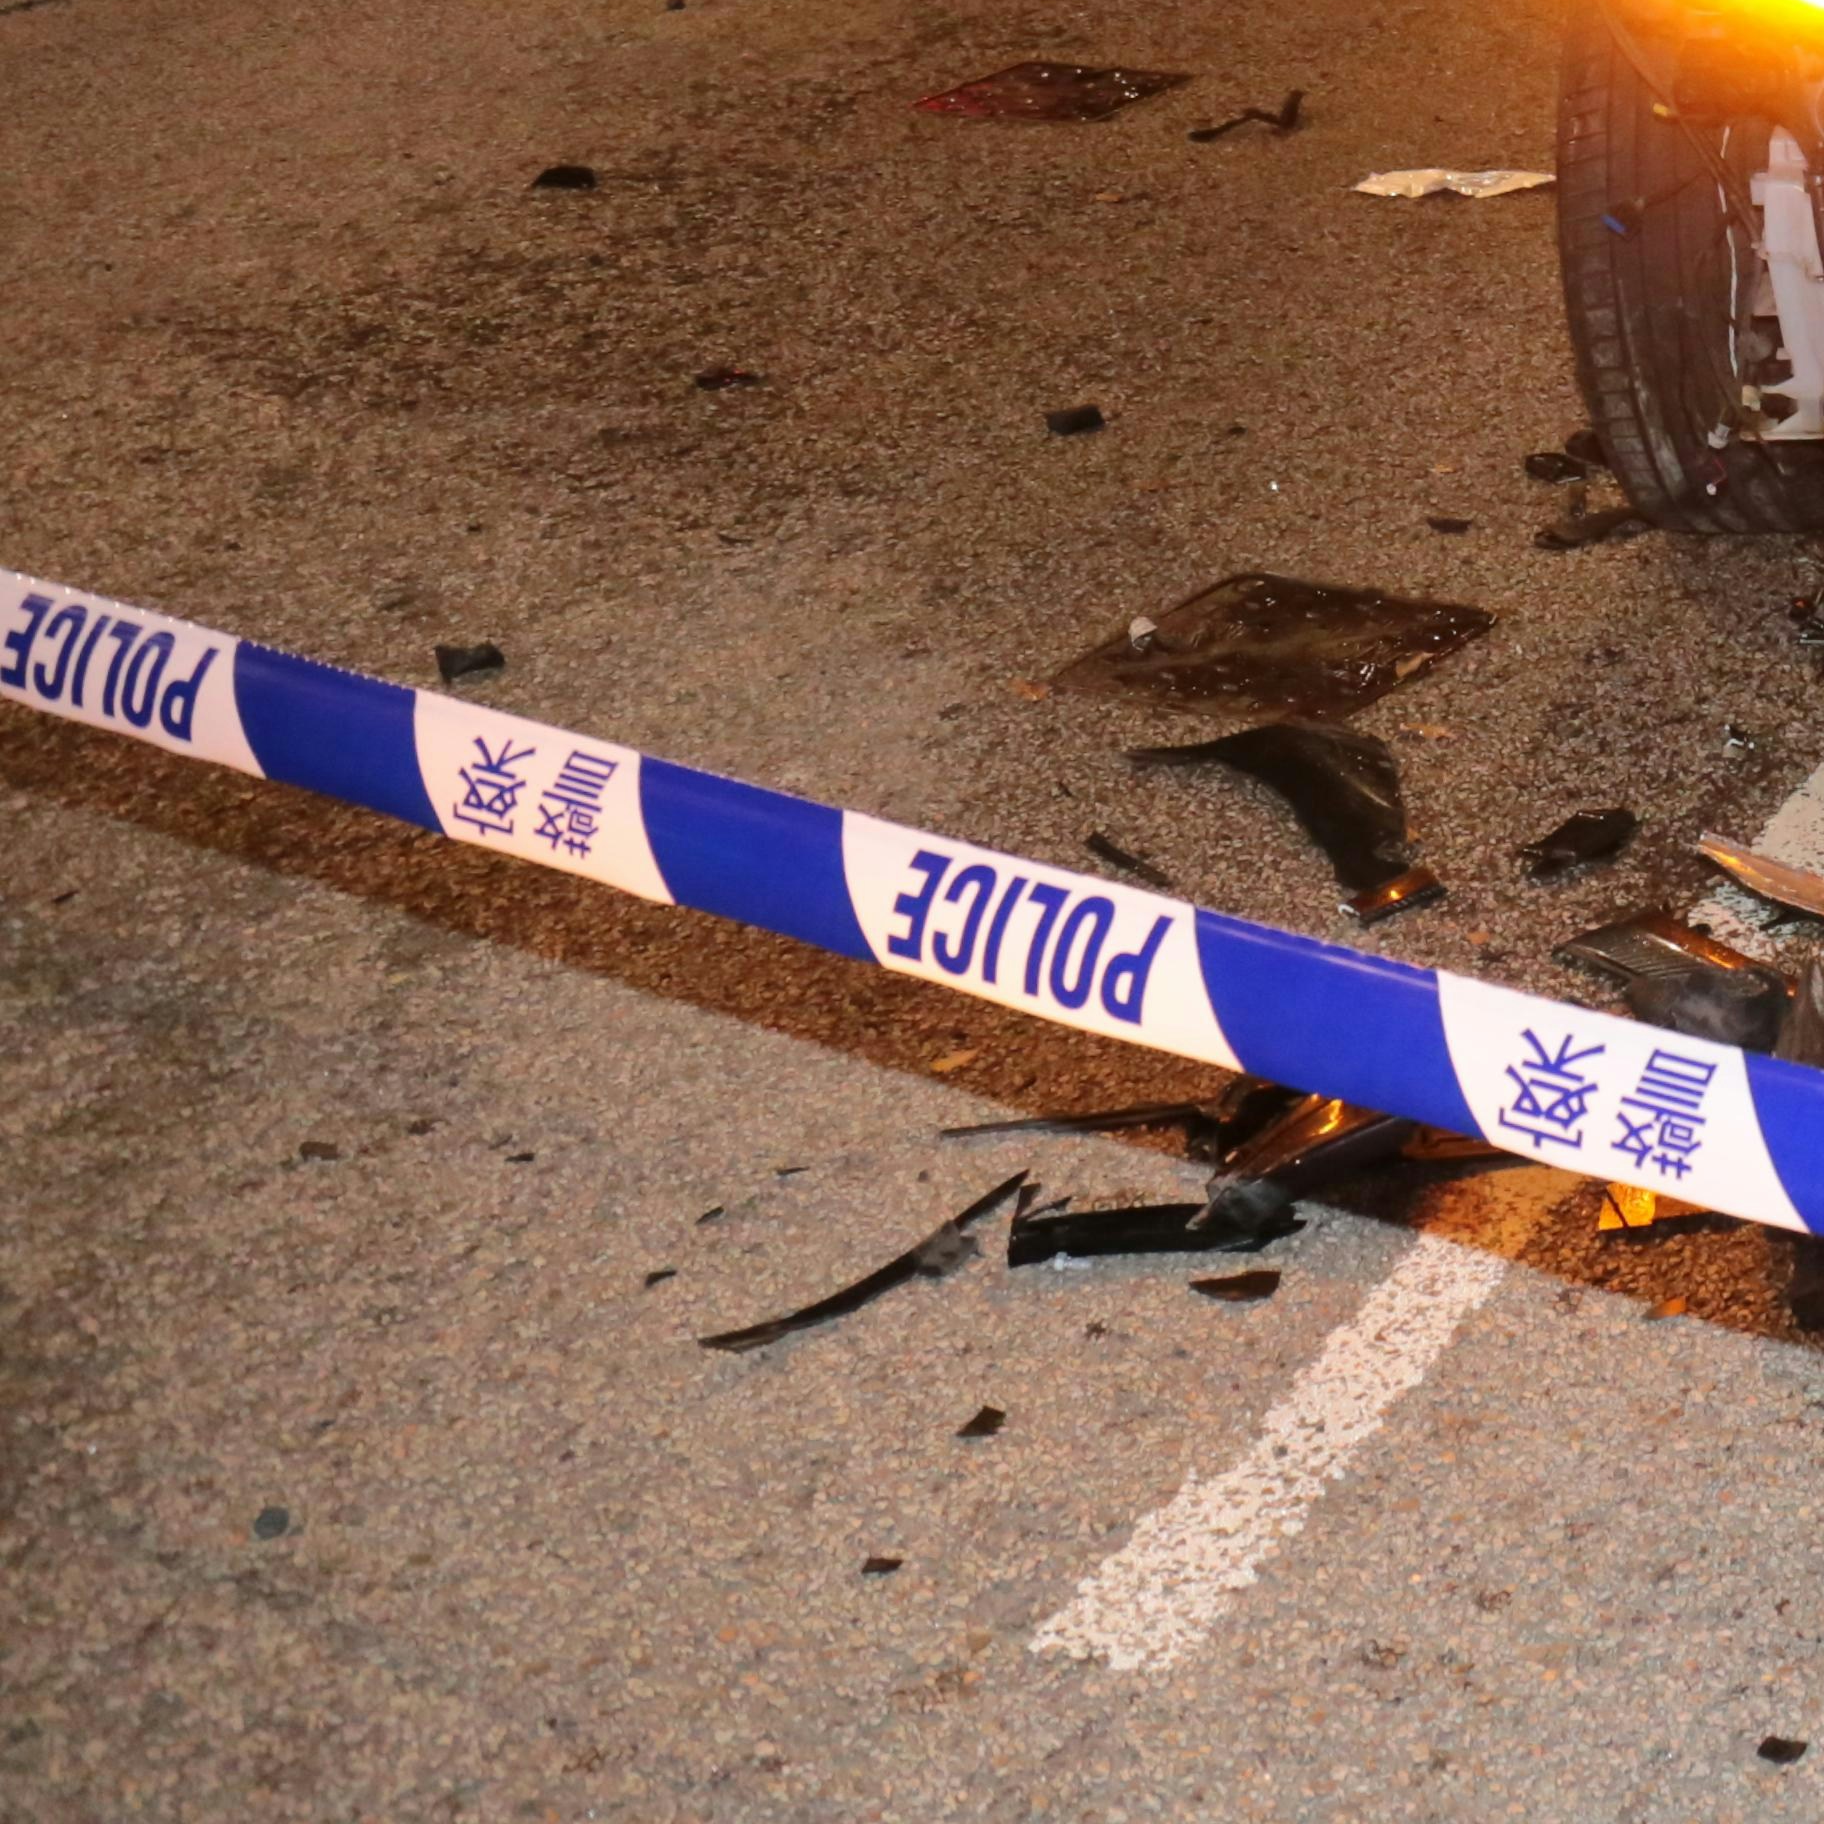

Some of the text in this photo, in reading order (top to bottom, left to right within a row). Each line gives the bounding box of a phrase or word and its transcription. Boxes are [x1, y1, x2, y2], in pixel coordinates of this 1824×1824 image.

[0, 592, 217, 743] POLICE
[453, 735, 620, 861] 警察
[887, 850, 1176, 1027] POLICE
[1497, 1026, 1720, 1182] 警察
